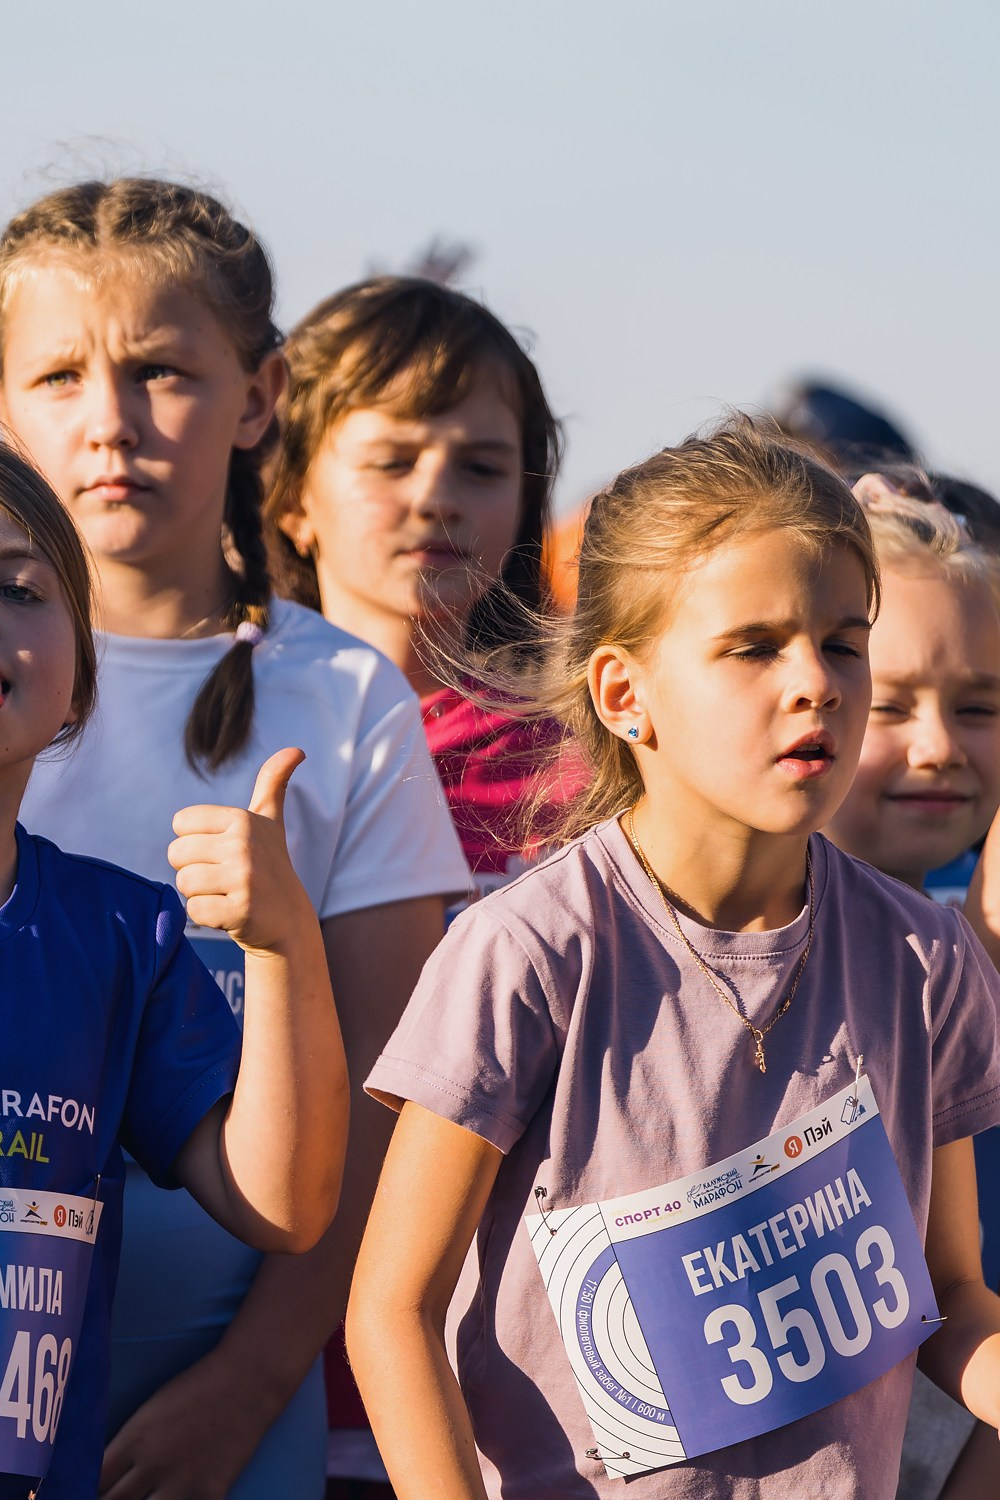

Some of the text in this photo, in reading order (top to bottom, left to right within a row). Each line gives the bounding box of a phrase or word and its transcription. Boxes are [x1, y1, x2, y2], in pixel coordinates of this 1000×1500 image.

[803, 1116, 833, 1147] Пэй
[703, 1167, 738, 1189] КАЛУЖСКИЙ
[693, 1180, 743, 1209] МАРАФОН
[68, 1209, 84, 1229] Пэй
[615, 1206, 661, 1227] СПОРТ
[664, 1200, 682, 1213] 40
[681, 1167, 873, 1296] ЕКАТЕРИНА
[703, 1225, 910, 1405] 3503
[576, 1279, 665, 1422] 17:50 фиолетовый забег №1 600 м
